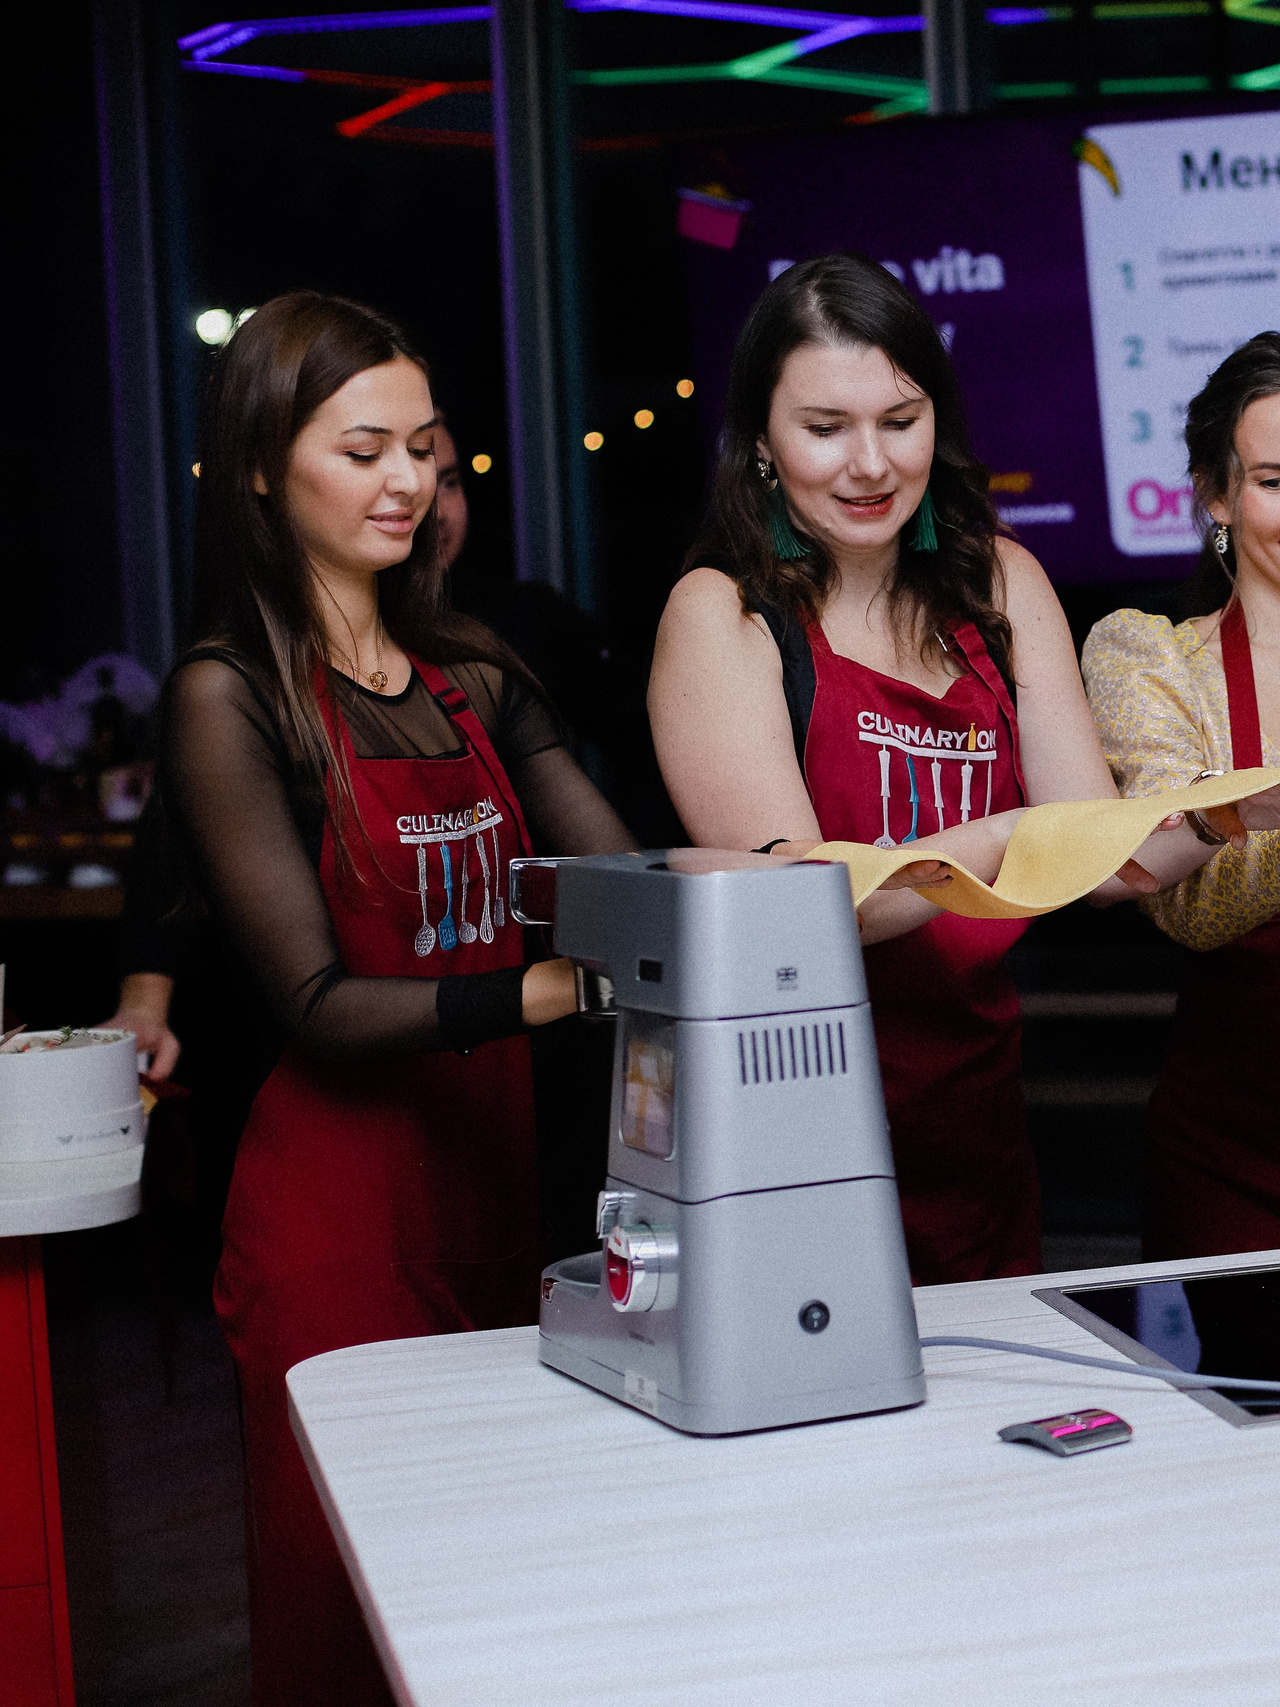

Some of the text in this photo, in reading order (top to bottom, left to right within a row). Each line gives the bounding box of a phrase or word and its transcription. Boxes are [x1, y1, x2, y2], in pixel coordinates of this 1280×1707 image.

[913, 246, 1004, 295] vita
[1119, 260, 1135, 290] 1
[1123, 334, 1145, 369] 2
[1130, 410, 1152, 444] 3
